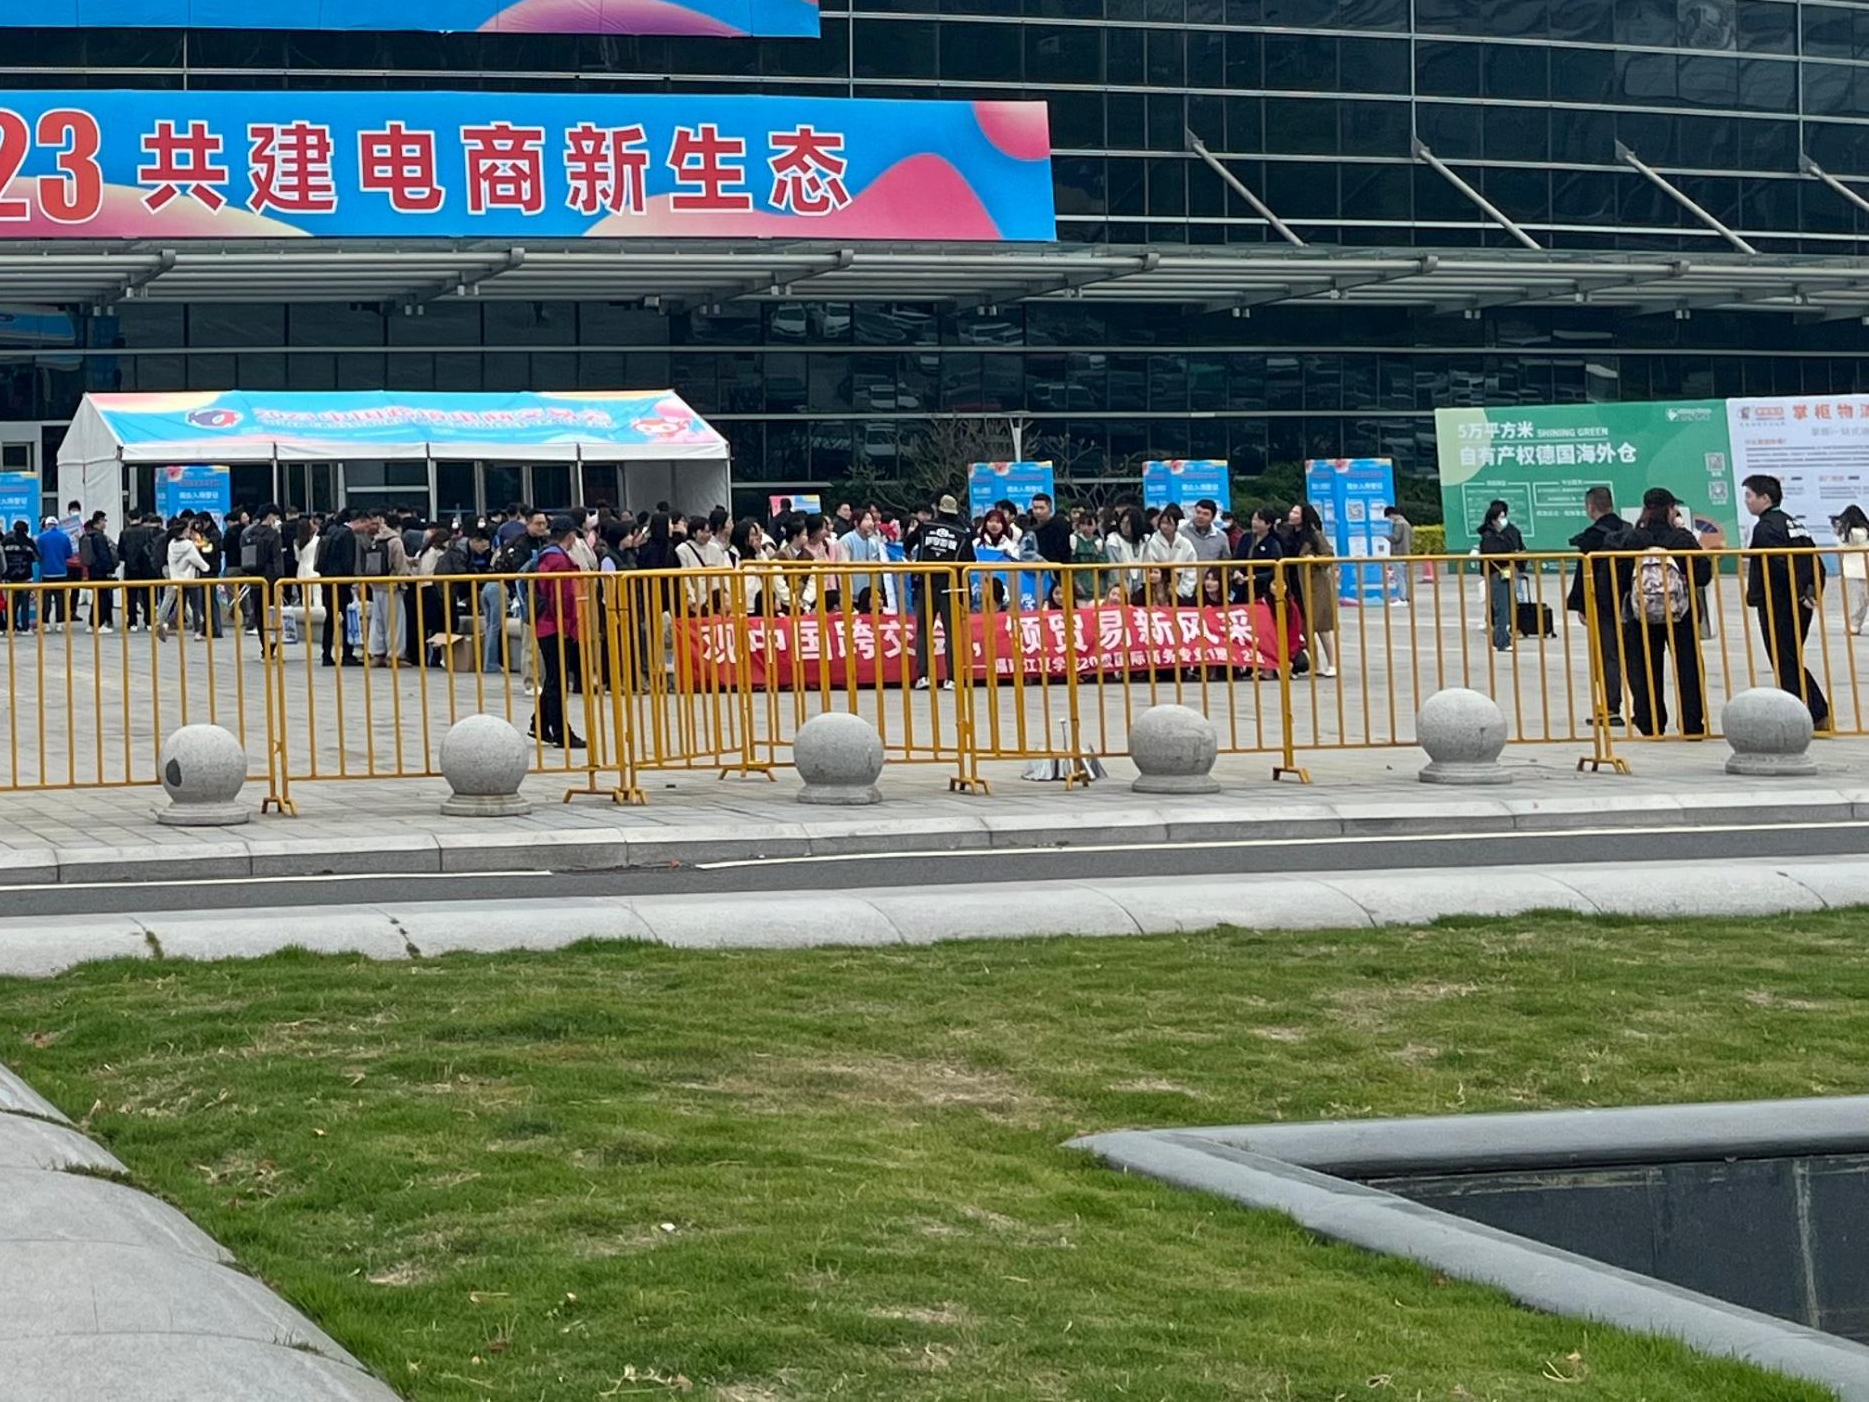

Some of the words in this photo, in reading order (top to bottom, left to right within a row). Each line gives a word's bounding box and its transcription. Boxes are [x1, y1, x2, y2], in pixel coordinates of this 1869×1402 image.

[137, 119, 854, 217] 共建电商新生态
[1458, 421, 1534, 440] 5万平方米
[1460, 442, 1637, 466] 自有产权德国海外仓
